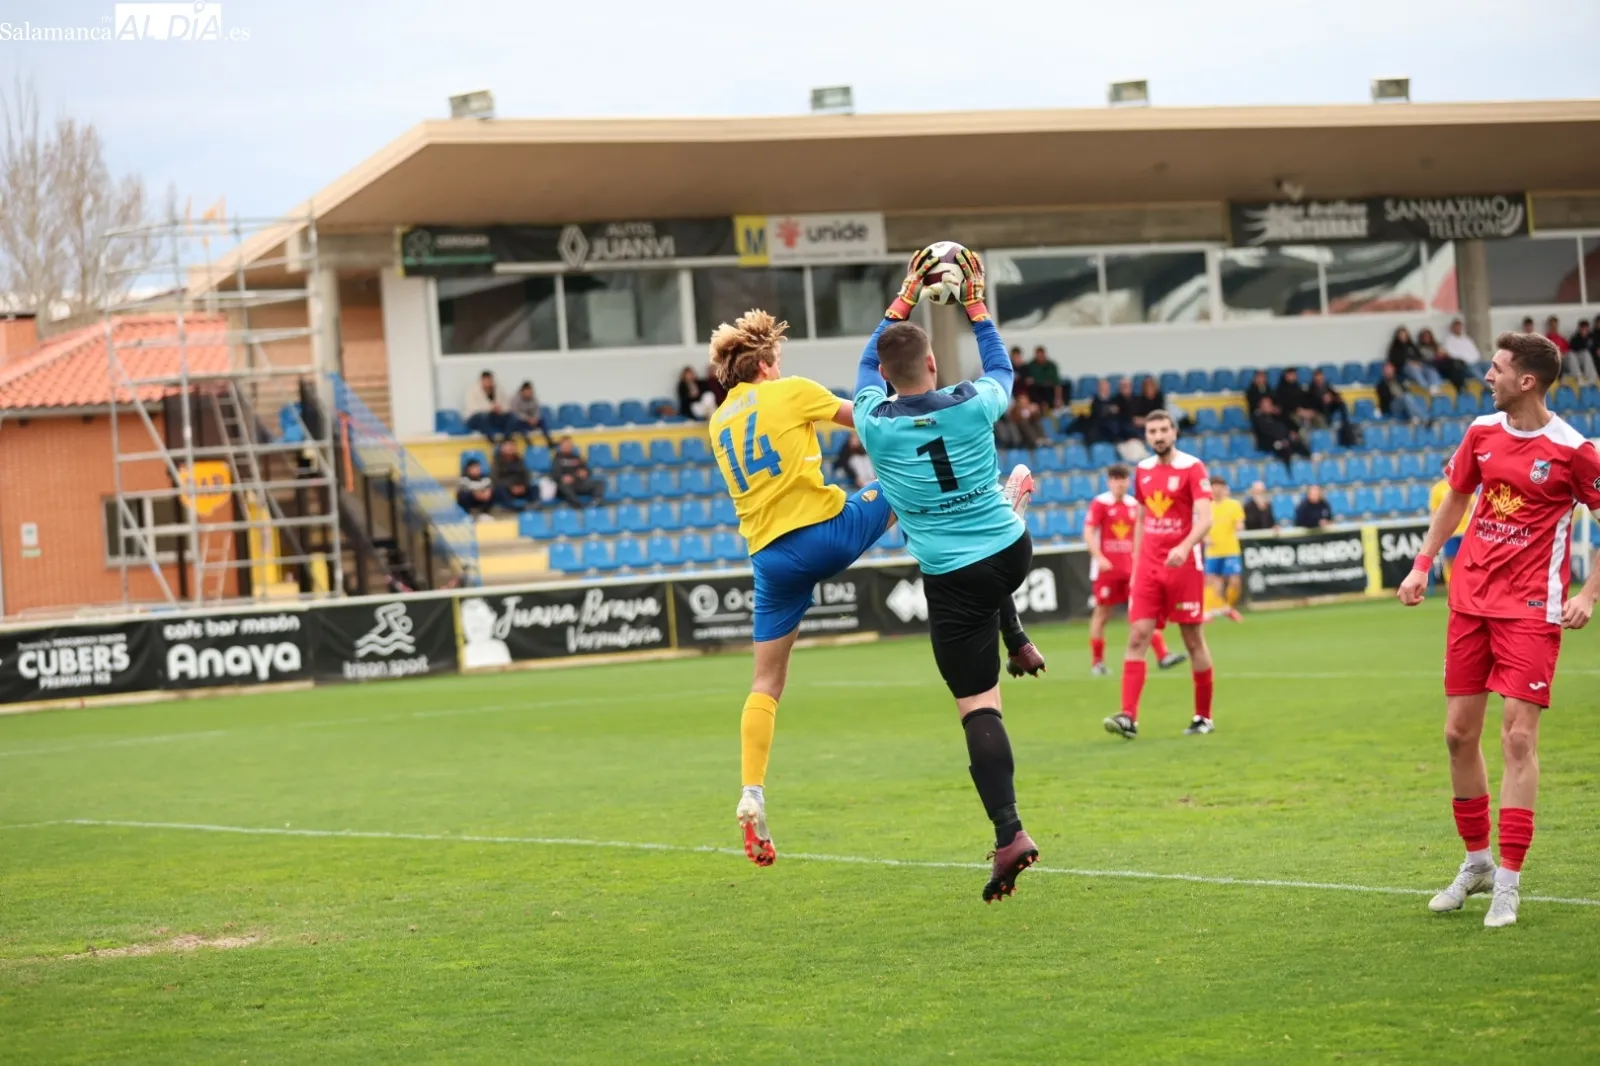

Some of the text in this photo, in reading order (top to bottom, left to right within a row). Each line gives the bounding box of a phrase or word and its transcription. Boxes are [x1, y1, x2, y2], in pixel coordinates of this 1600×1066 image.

[1383, 195, 1508, 222] SANMAXIMO
[806, 219, 868, 243] unide
[1428, 218, 1502, 239] TELECOM
[591, 235, 676, 260] JUANVI
[719, 411, 782, 493] 14
[916, 436, 959, 493] 1
[1495, 522, 1532, 538] RURAL
[1244, 546, 1296, 569] DAVID
[207, 616, 238, 636] bar
[17, 642, 131, 679] CUBERS
[166, 641, 303, 681] Anaya
[388, 654, 430, 678] sport
[39, 674, 93, 691] PREMIUM
